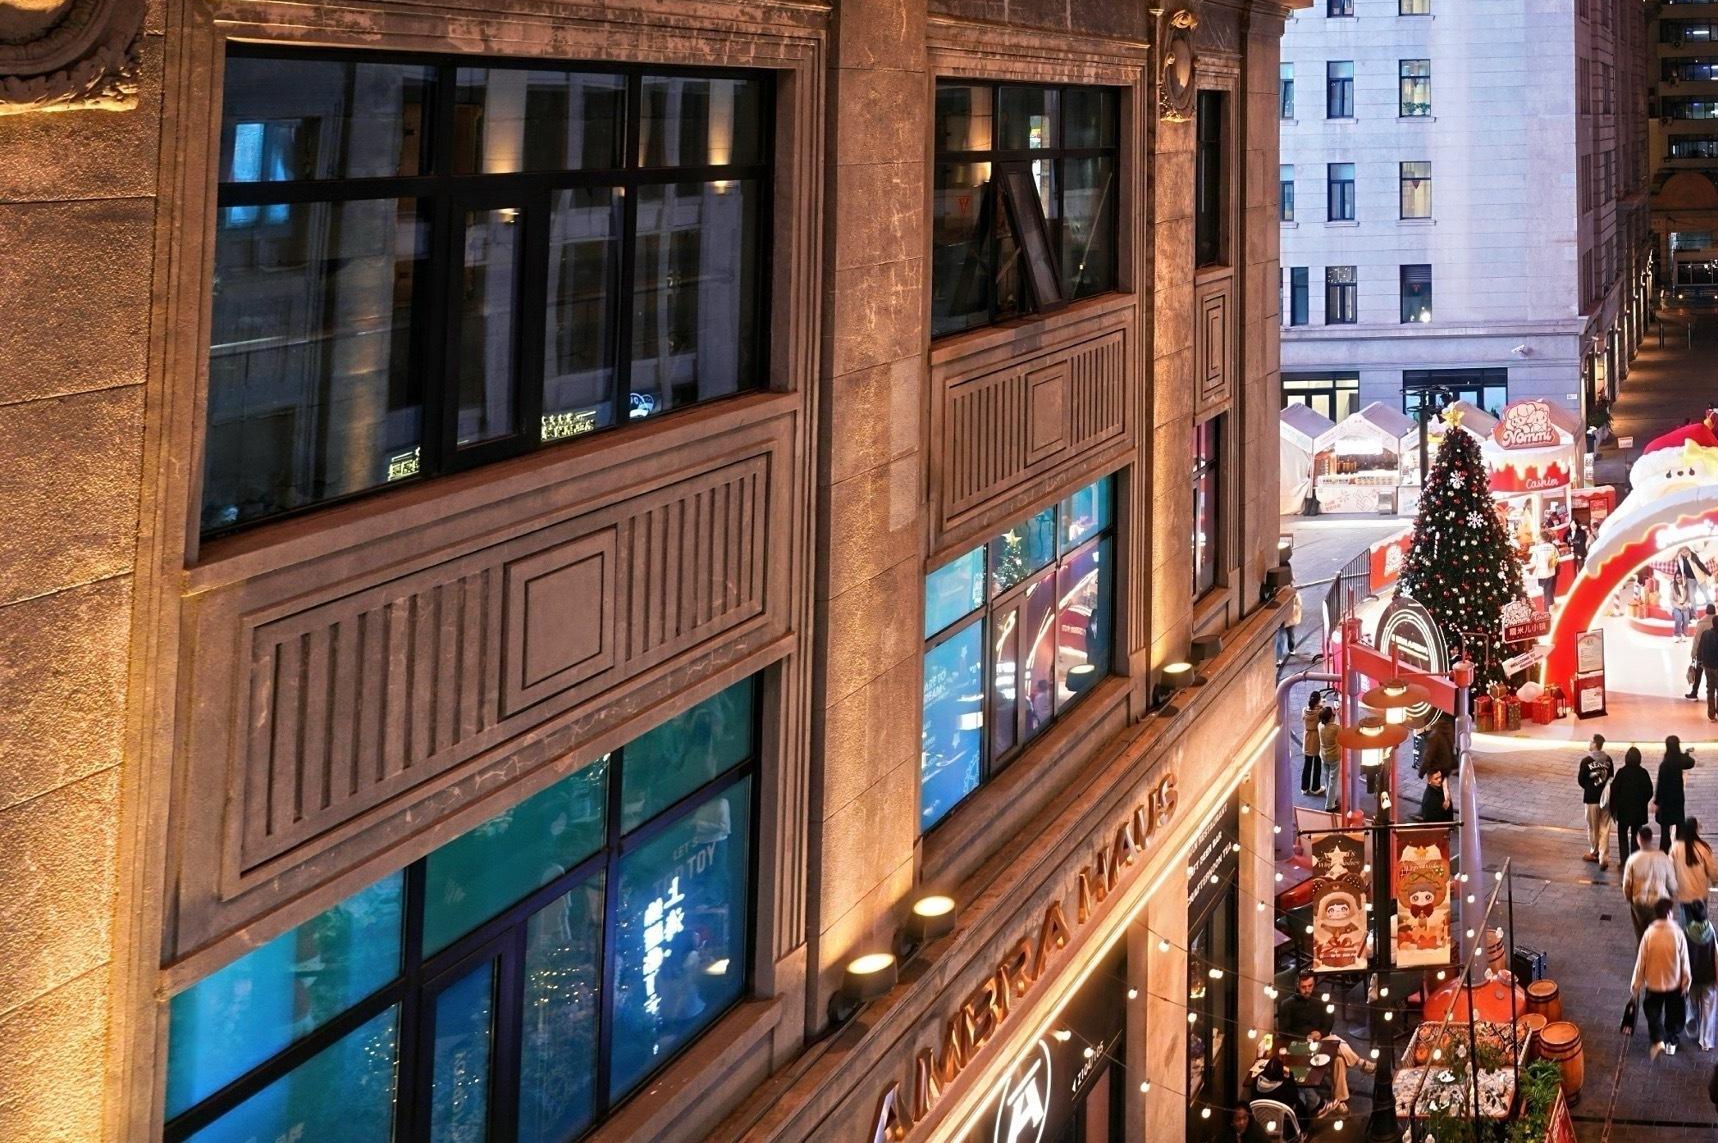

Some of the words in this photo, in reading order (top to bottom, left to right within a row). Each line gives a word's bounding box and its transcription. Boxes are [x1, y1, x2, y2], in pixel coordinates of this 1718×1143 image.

[1502, 429, 1553, 447] Nommi
[1526, 476, 1558, 490] Cashier
[1212, 830, 1222, 849] BAR
[687, 839, 718, 880] TOY
[872, 899, 1071, 1143] AMBRA
[1077, 773, 1179, 924] HAUS
